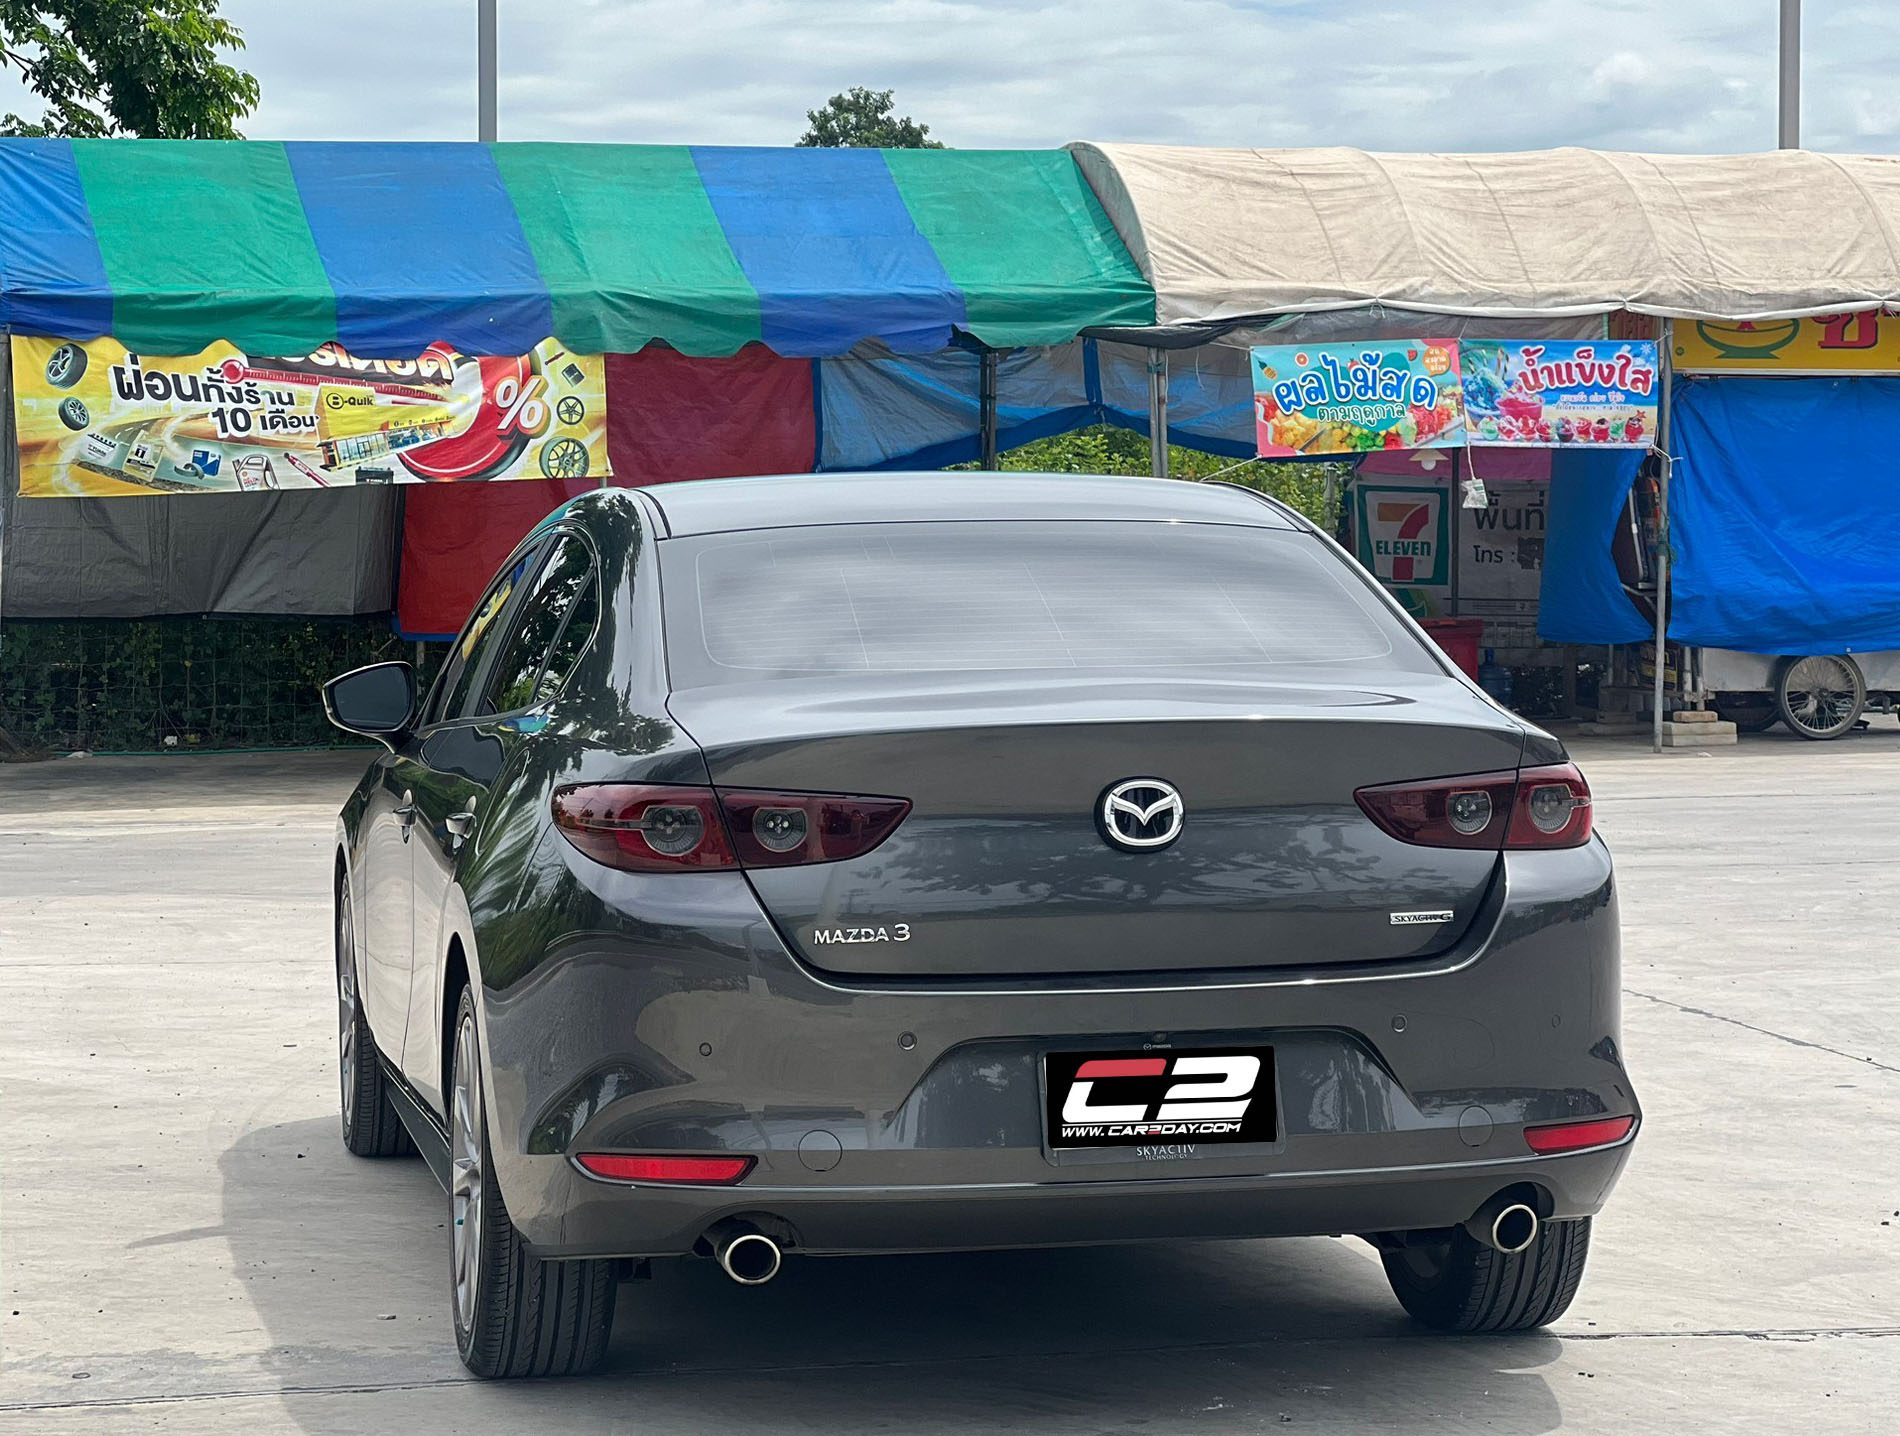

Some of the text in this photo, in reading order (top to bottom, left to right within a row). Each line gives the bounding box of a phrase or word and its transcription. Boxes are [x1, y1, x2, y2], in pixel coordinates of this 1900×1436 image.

[1518, 347, 1652, 394] น้ำแข็งใส
[1273, 352, 1438, 414] ผลไม้สด
[326, 392, 375, 410] B-Quik
[211, 407, 252, 434] 10
[1317, 404, 1406, 426] ตามฤดูกาล
[813, 923, 911, 945] MAZDA 3
[1136, 1144, 1196, 1157] SKYACTIV
